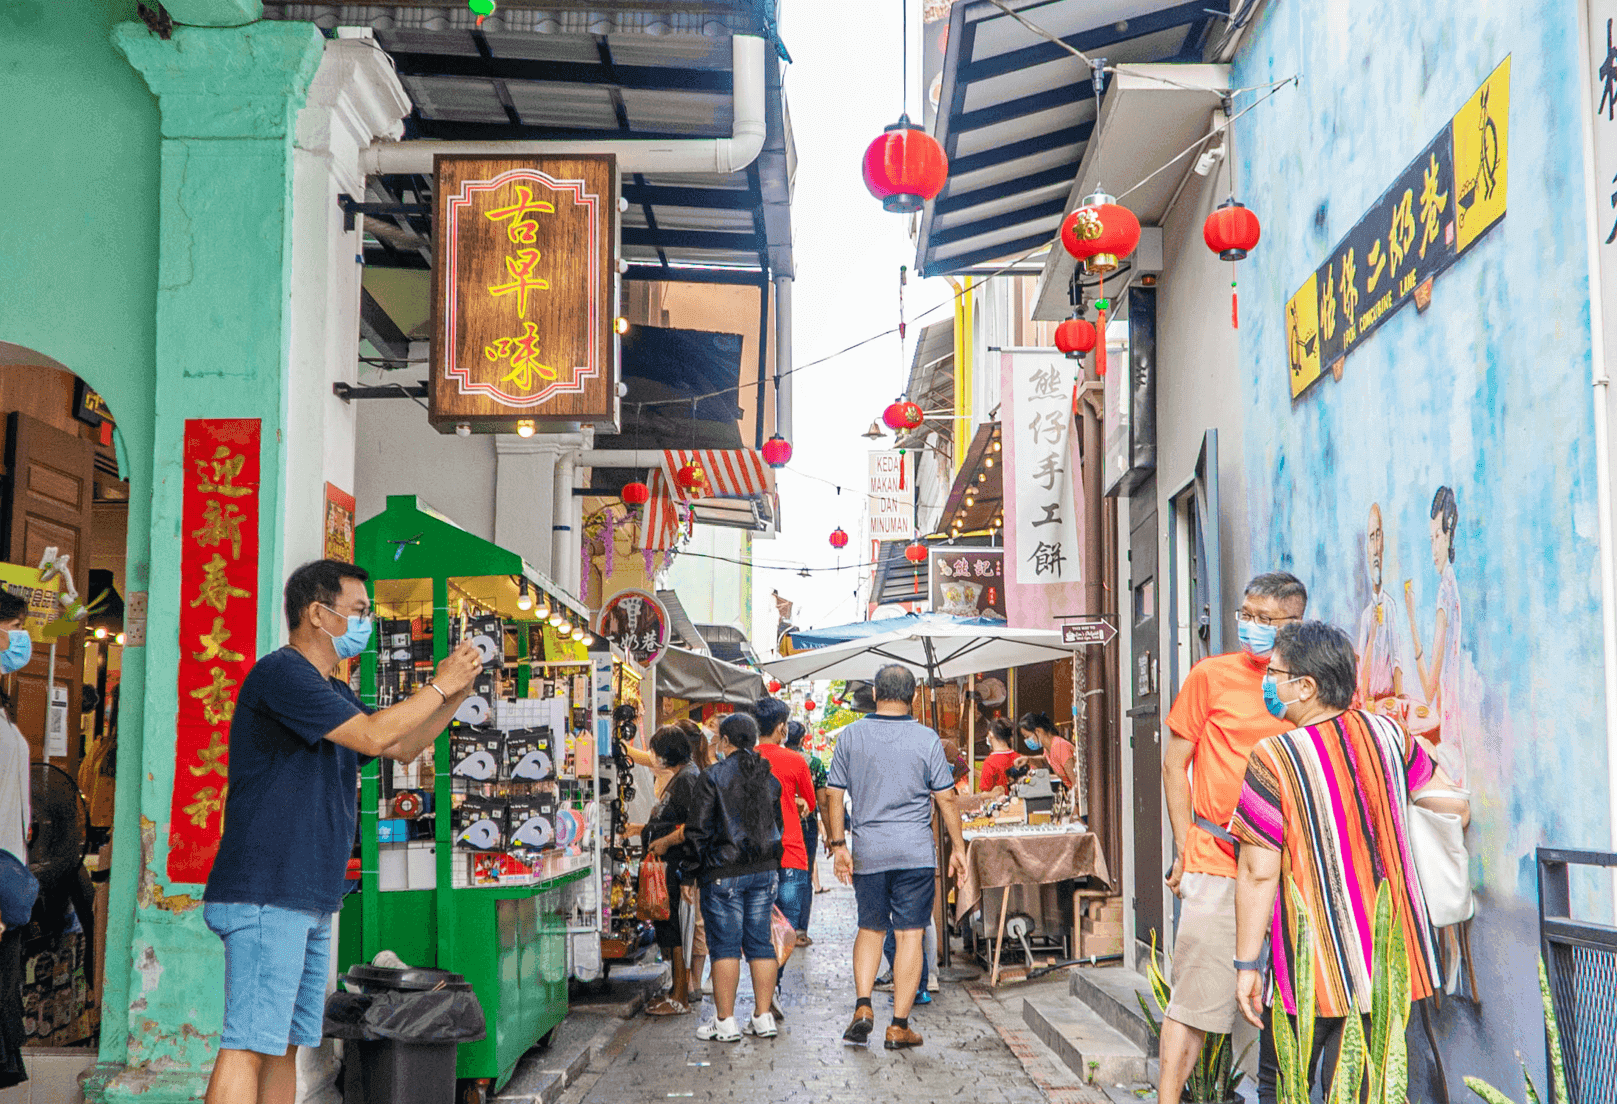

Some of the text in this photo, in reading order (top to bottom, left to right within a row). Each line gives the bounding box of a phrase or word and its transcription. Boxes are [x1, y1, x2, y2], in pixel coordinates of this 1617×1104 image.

[484, 185, 557, 390] 古早味
[1320, 152, 1449, 341] 怡保二奶巷
[1343, 267, 1418, 350] IPOH CONCUBINE LANE
[871, 477, 908, 492] MAKANN
[871, 517, 908, 533] MINUMAN
[881, 497, 898, 512] DAN
[1027, 363, 1068, 578] 熊仔手工餅
[182, 445, 253, 837] 迎新春大吉大利
